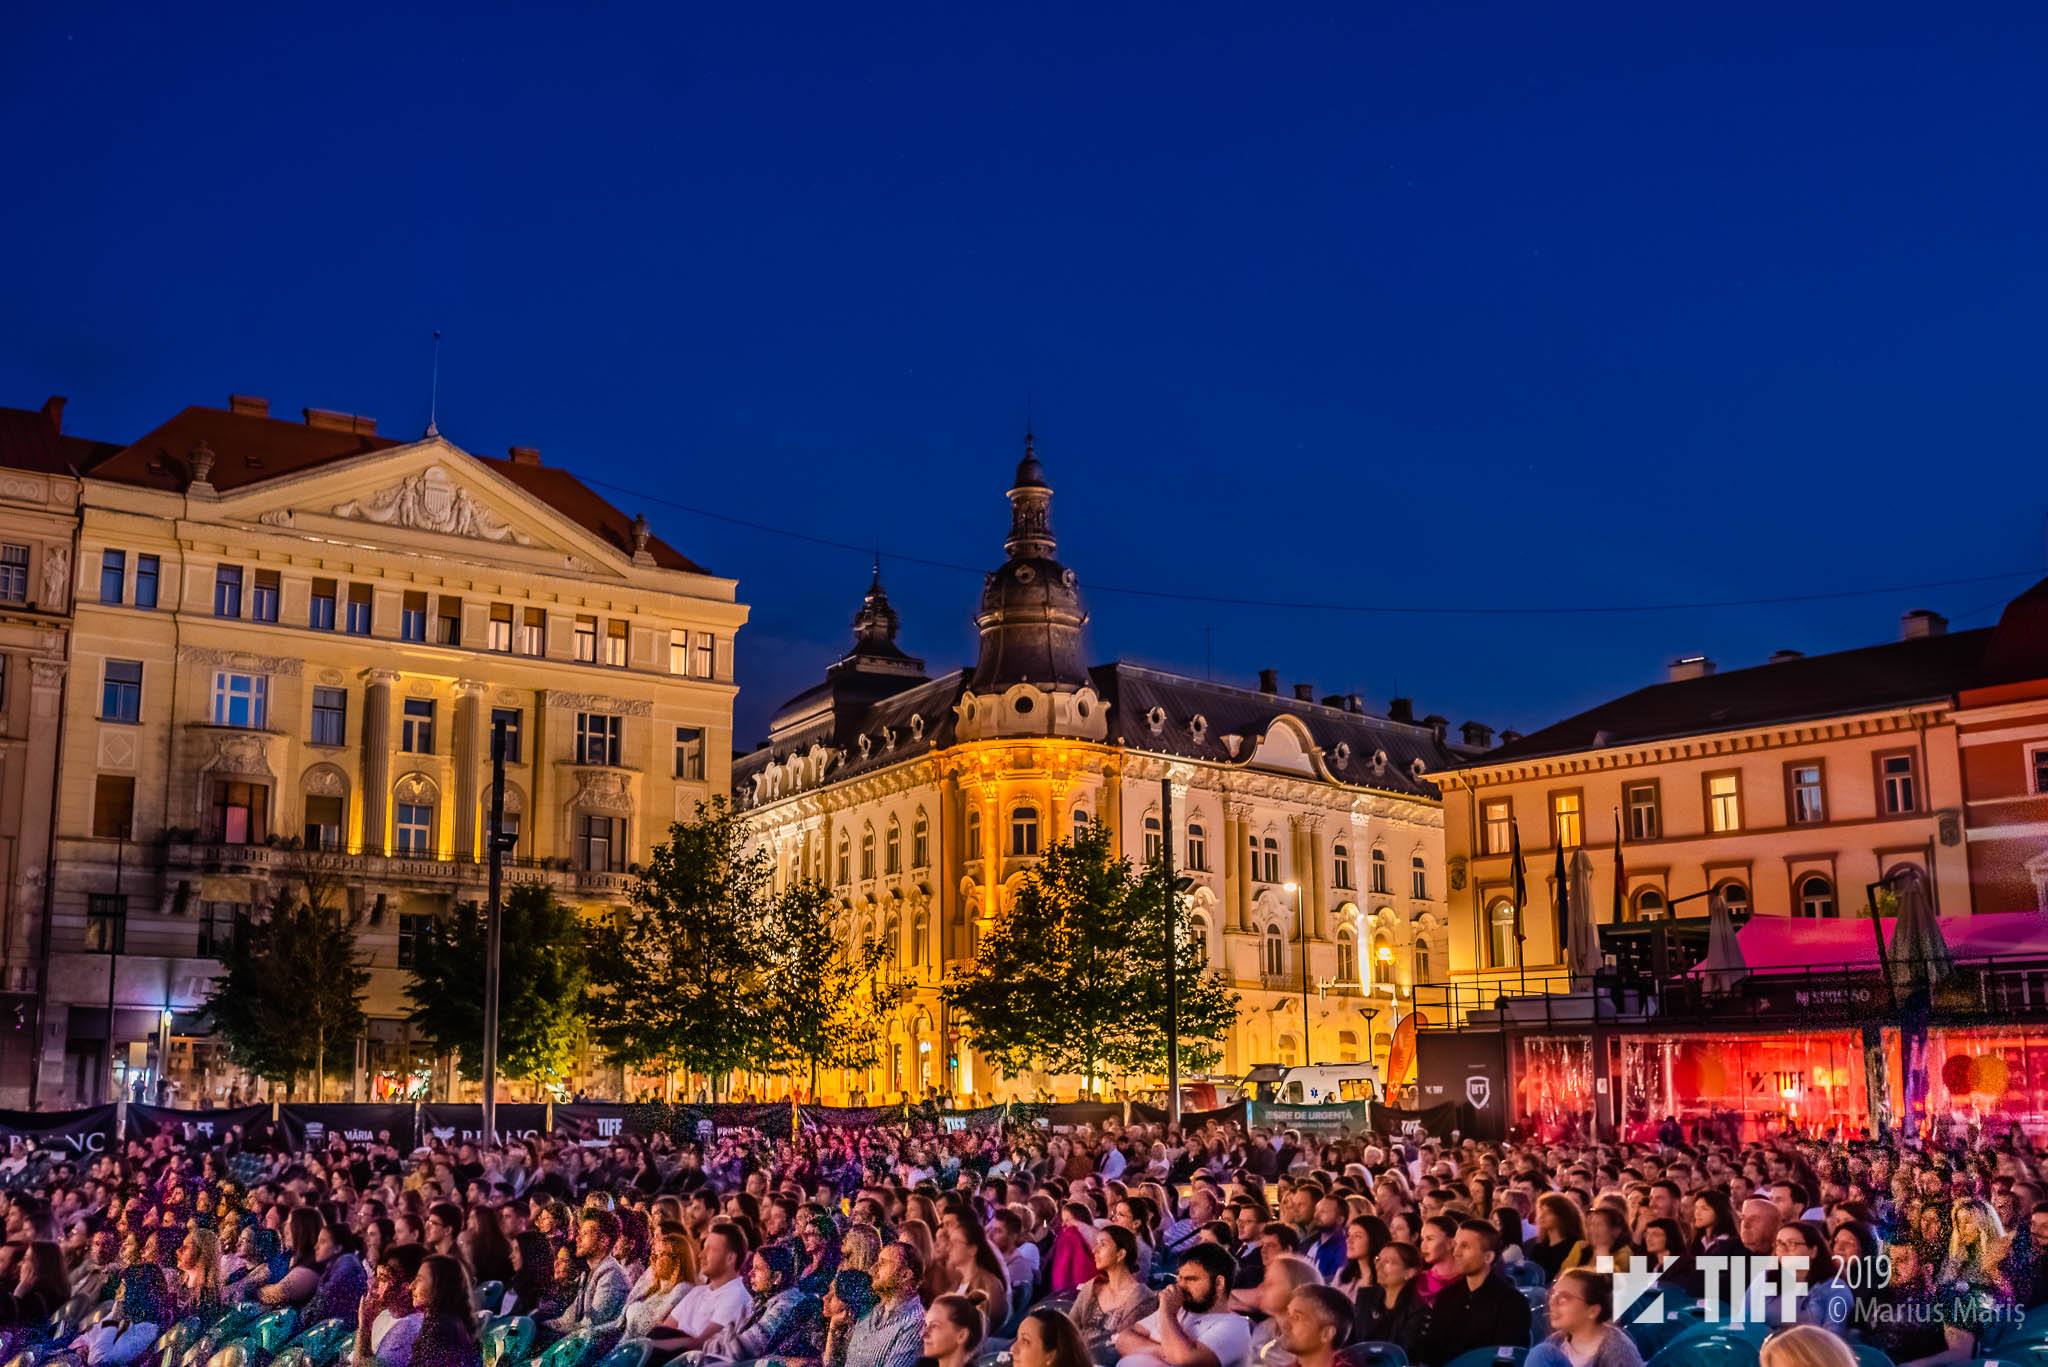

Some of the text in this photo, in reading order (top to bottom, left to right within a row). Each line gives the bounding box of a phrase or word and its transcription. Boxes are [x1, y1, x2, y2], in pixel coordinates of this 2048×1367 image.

[1471, 1084, 1485, 1094] BT
[1294, 1111, 1306, 1119] DE
[597, 1118, 623, 1136] TIFF
